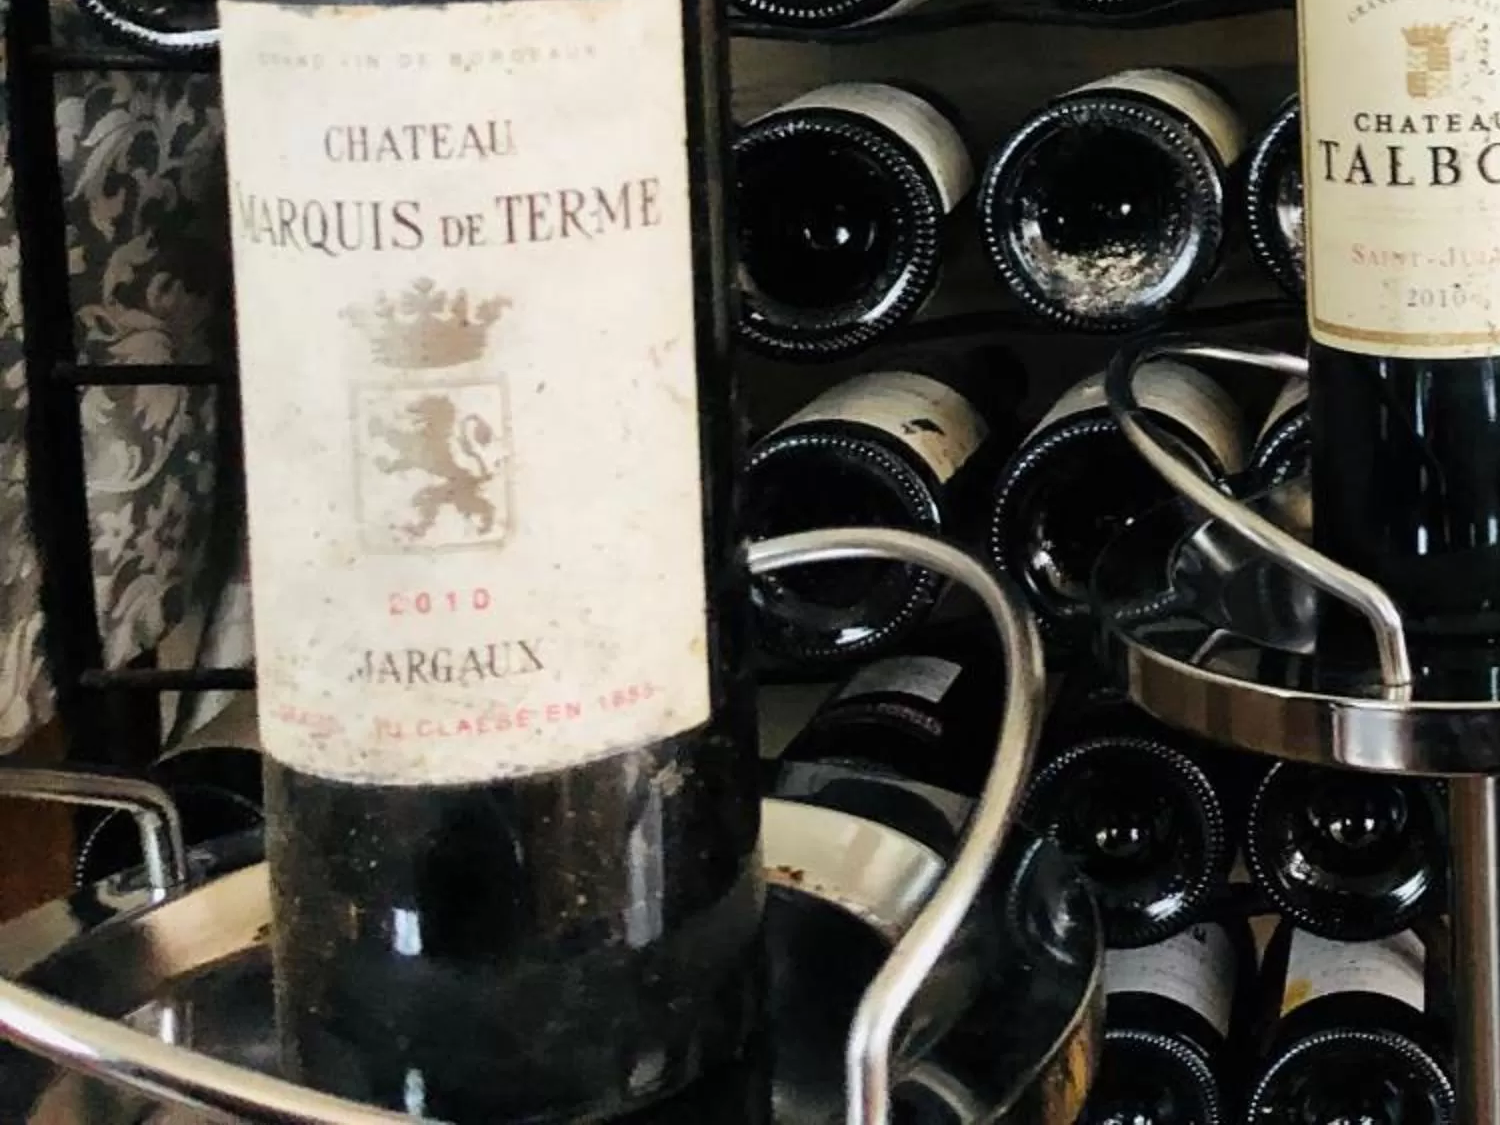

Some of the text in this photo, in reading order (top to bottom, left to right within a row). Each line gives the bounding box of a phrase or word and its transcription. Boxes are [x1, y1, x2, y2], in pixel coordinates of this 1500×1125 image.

[323, 119, 514, 163] CHATEAU
[234, 181, 425, 257] MARQUIS
[494, 177, 662, 246] TERME
[1406, 287, 1468, 309] 2010
[387, 587, 492, 617] 2010
[544, 702, 582, 725] EN
